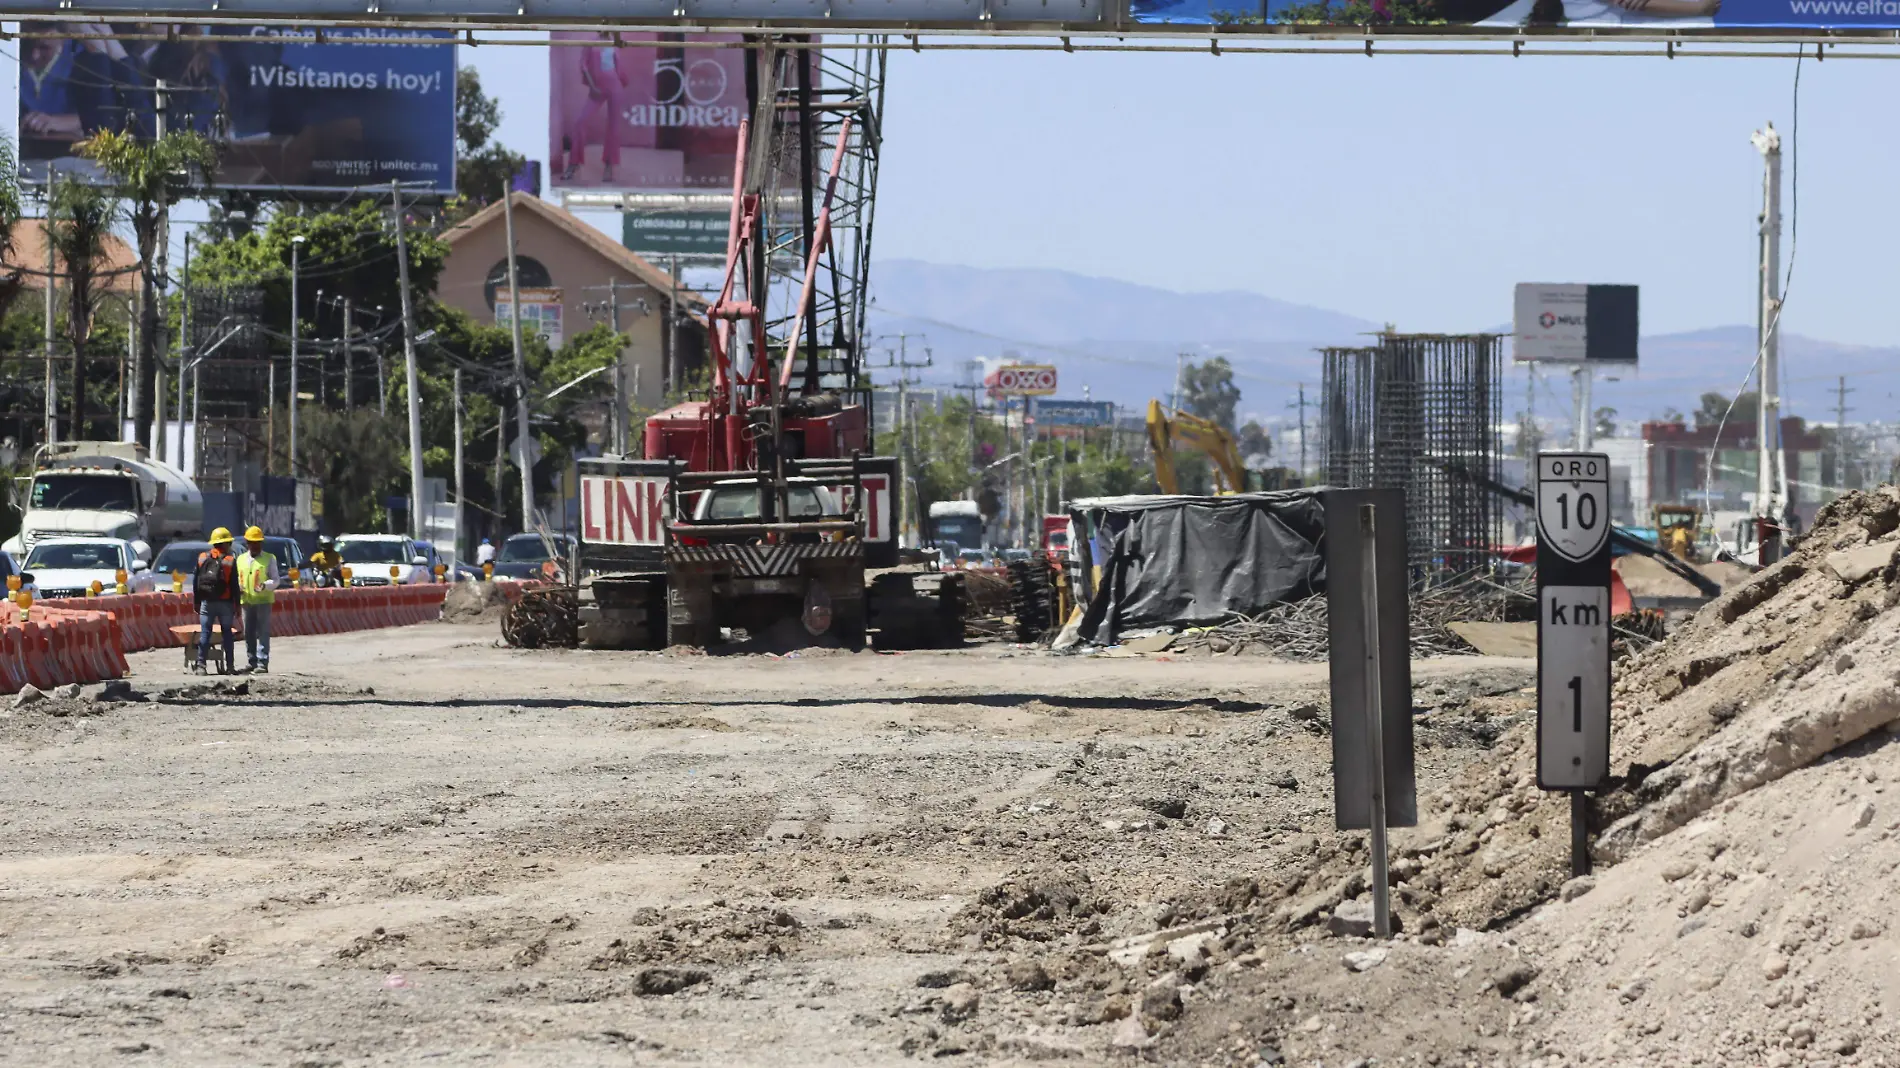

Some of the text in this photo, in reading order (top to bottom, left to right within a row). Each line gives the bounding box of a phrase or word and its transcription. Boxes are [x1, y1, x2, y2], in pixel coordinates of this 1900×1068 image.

[1790, 0, 1900, 15] www.elfa
[250, 66, 441, 94] ¡Visítanos hoy!
[648, 58, 727, 105] 50
[1000, 371, 1054, 389] OXXO
[1552, 461, 1597, 476] QRO
[1556, 492, 1597, 530] 10
[1551, 597, 1600, 625] km
[1567, 676, 1582, 733] 1
